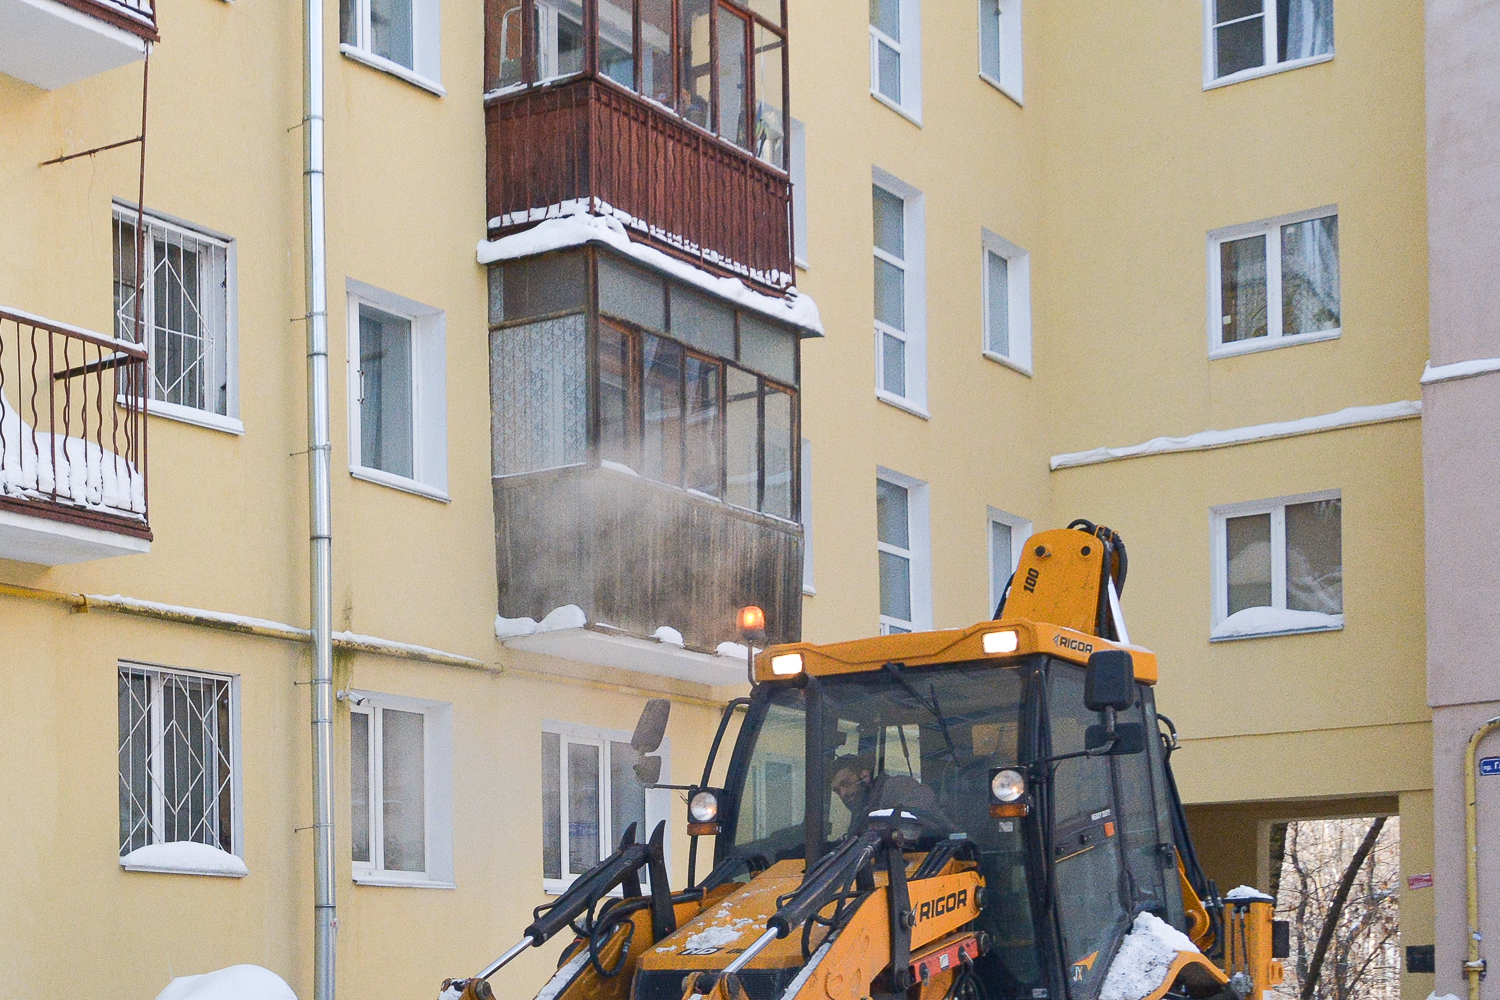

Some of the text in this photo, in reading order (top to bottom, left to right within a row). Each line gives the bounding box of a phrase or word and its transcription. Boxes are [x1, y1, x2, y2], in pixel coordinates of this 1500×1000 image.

[1023, 567, 1039, 594] 100
[1059, 636, 1094, 654] RIGOR
[919, 888, 968, 923] RIGOR
